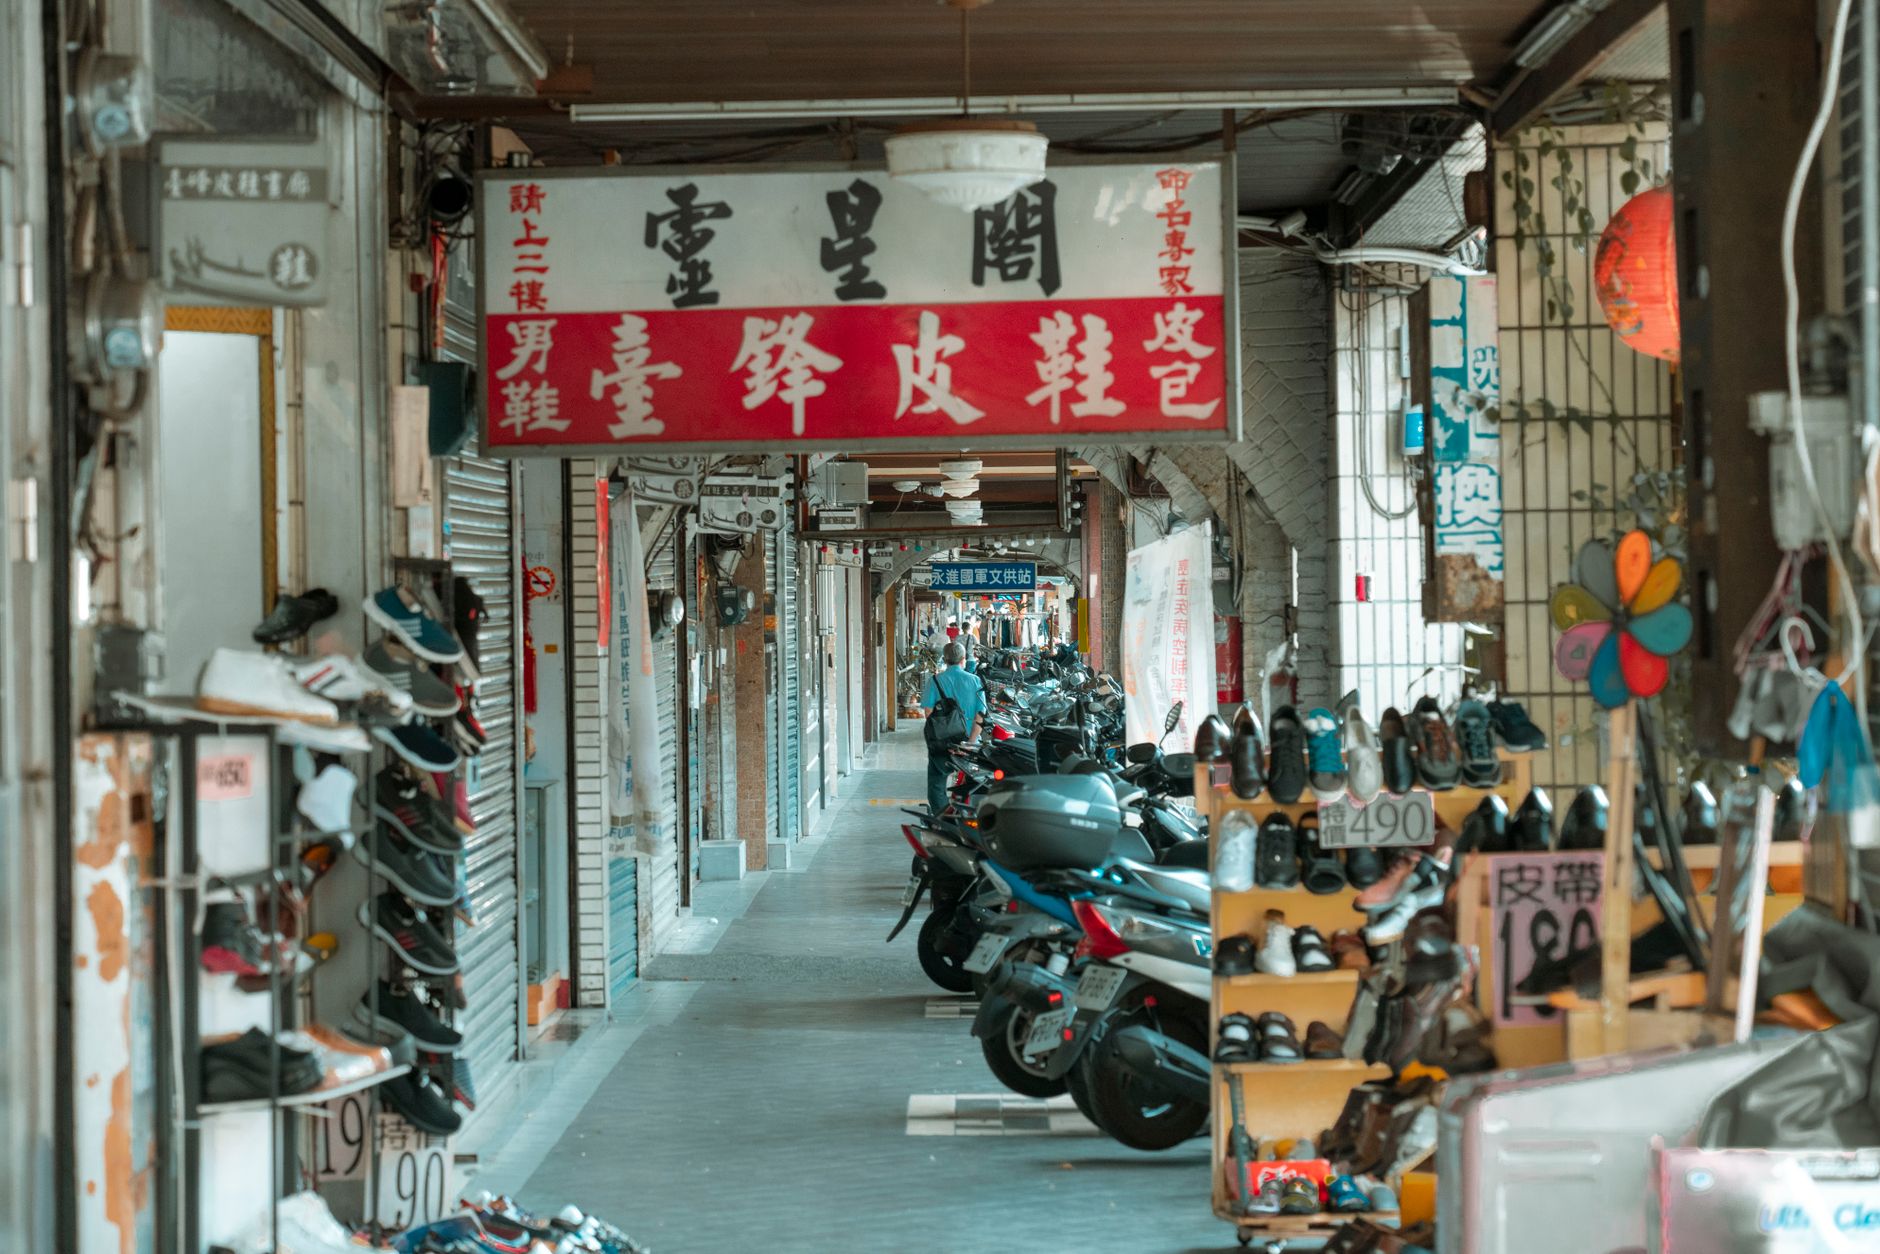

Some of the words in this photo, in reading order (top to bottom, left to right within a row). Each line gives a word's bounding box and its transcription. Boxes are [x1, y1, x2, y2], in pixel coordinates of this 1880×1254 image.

[508, 182, 550, 312] 請上二樓
[1155, 168, 1196, 296] 命名專家
[496, 318, 572, 437] 男鞋
[1142, 301, 1221, 420] 皮包
[932, 568, 1032, 585] 永進國軍文供站
[1350, 800, 1427, 843] 490
[1499, 862, 1602, 904] 皮帶
[311, 1097, 374, 1175] 19
